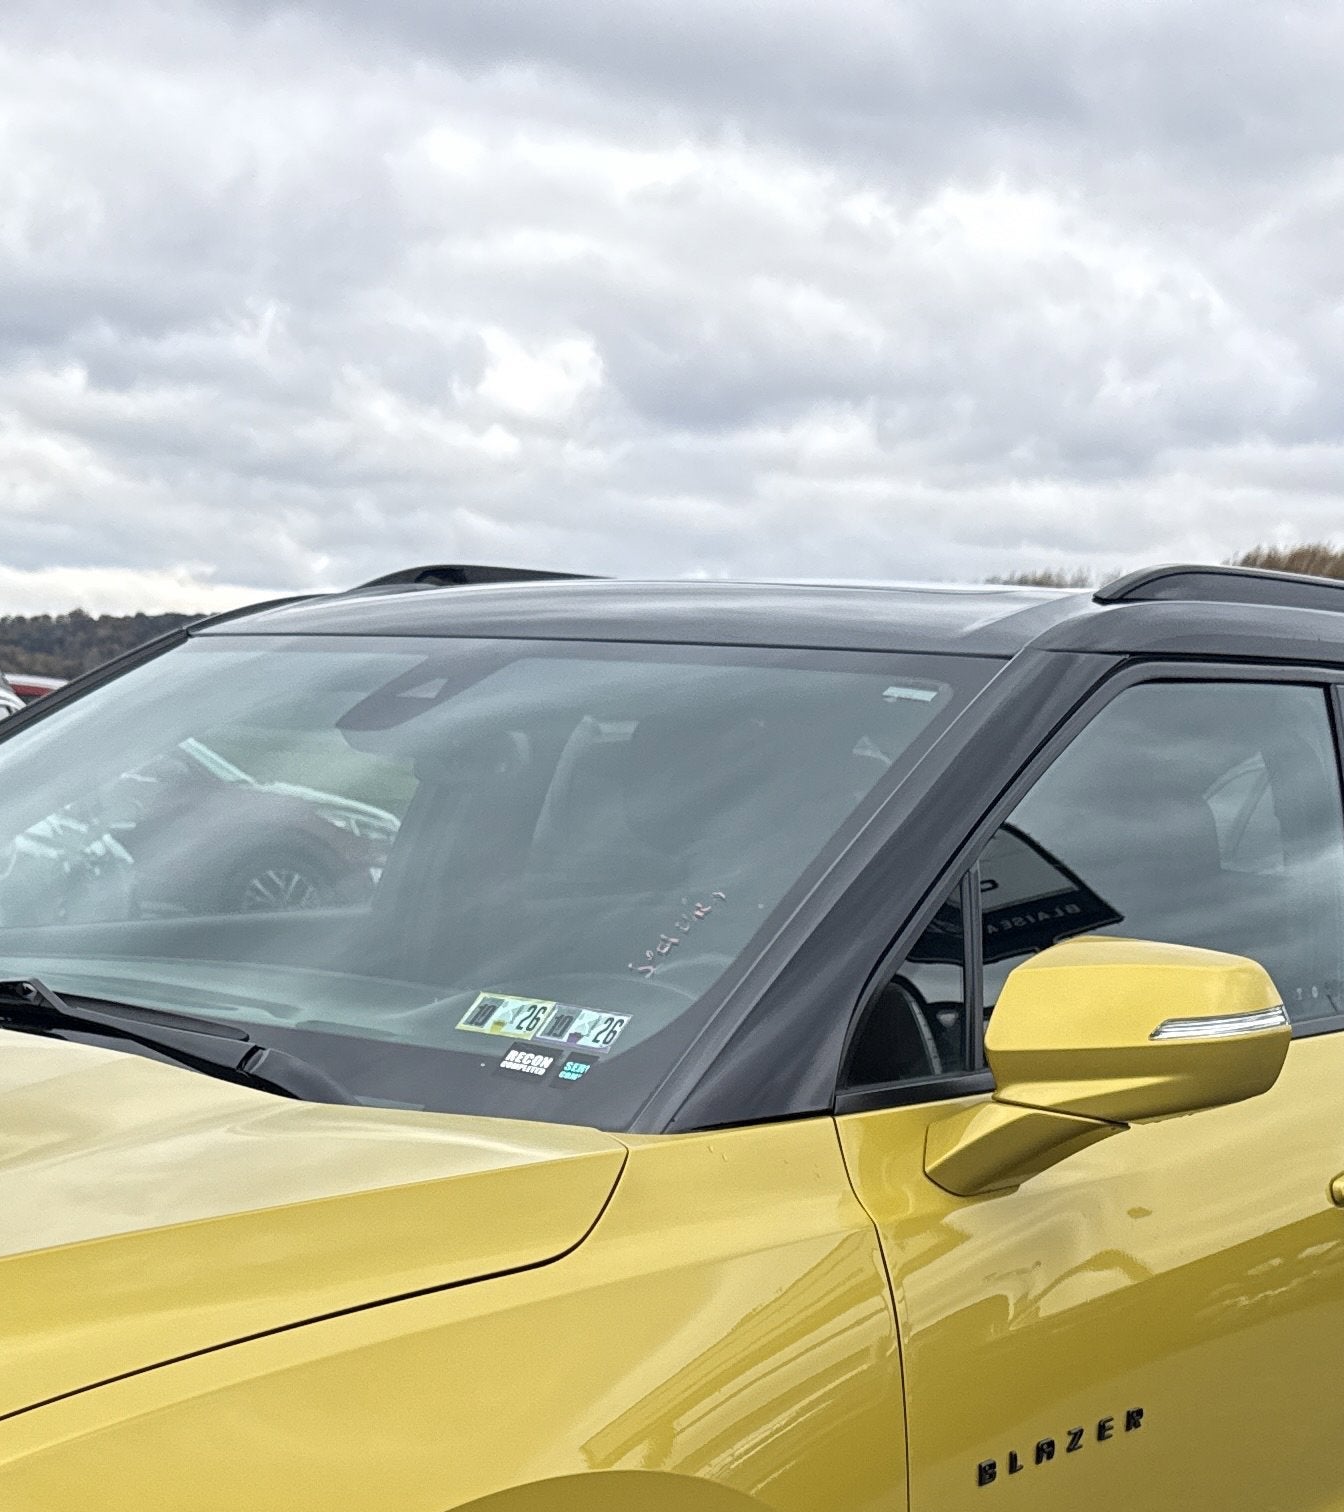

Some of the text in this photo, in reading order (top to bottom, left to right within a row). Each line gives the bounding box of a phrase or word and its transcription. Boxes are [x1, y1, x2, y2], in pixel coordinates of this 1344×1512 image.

[516, 1004, 548, 1031] 26
[591, 1017, 625, 1045] 26
[505, 1050, 554, 1069] RECON
[977, 1406, 1144, 1487] BLAZER
